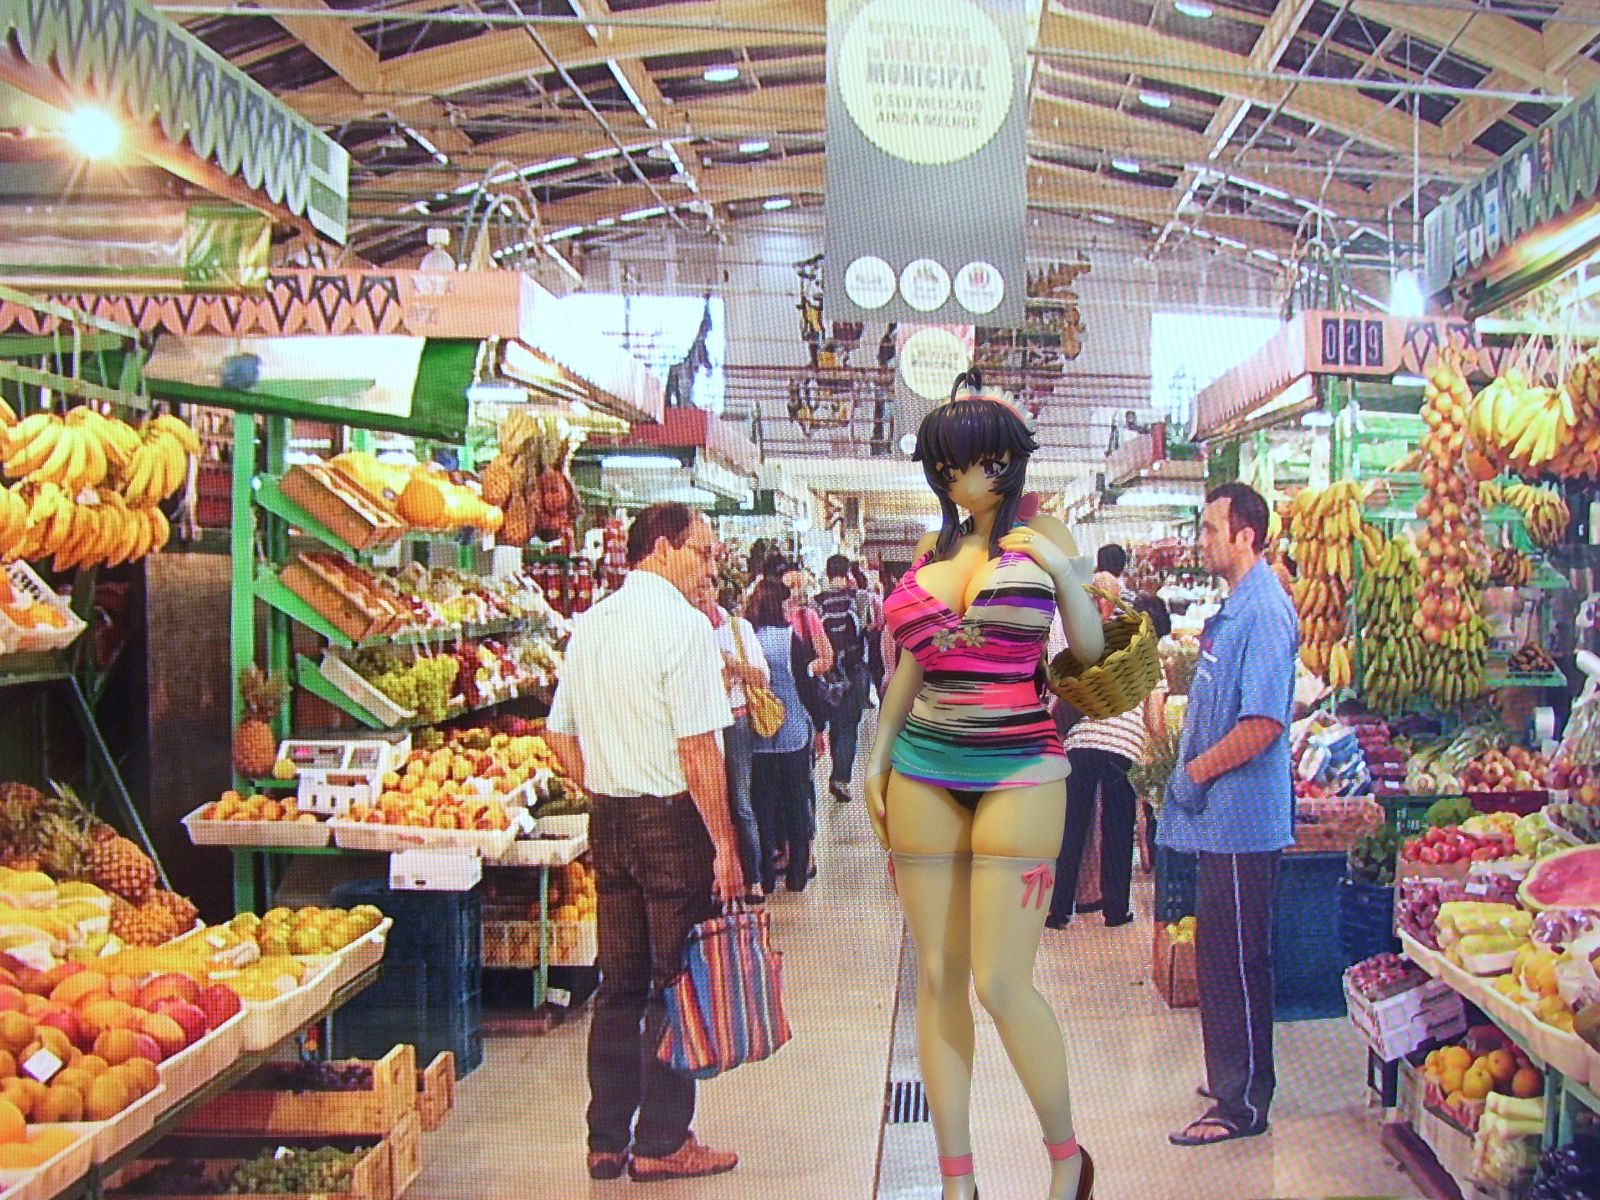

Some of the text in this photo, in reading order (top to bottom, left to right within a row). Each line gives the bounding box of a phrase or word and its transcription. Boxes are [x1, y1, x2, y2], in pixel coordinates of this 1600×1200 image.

[867, 61, 985, 91] MUNICIPAL
[876, 110, 920, 125] AINDA
[1325, 322, 1380, 361] 029
